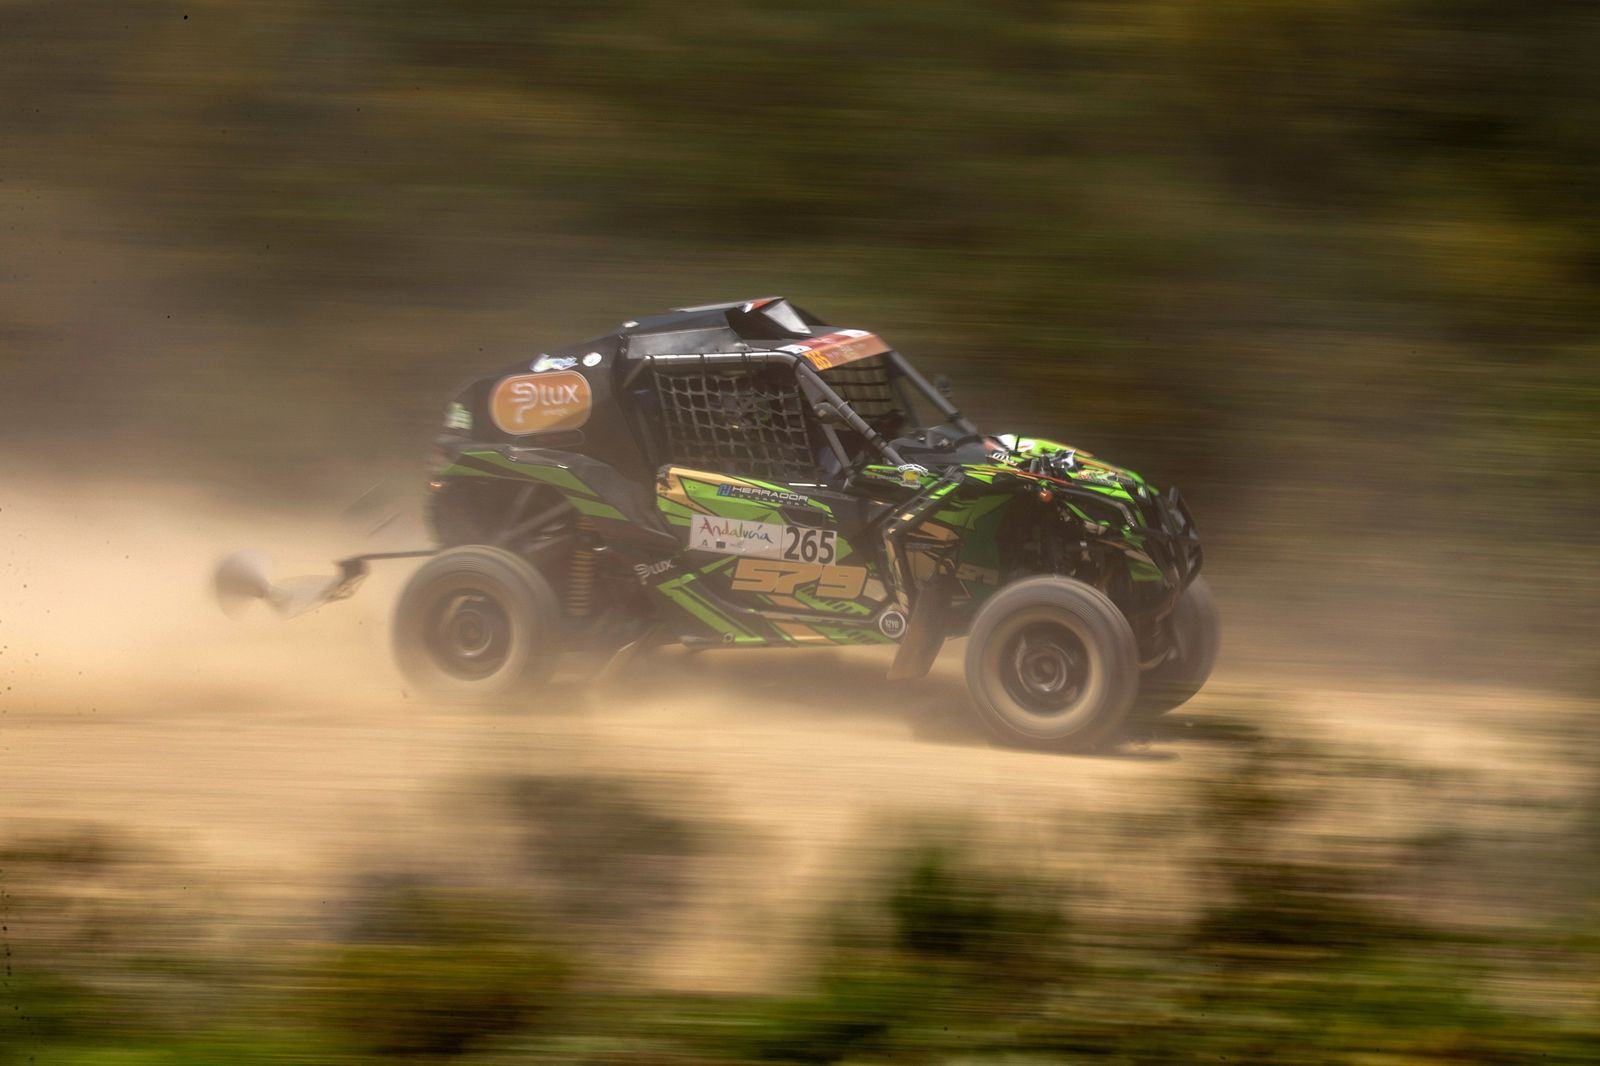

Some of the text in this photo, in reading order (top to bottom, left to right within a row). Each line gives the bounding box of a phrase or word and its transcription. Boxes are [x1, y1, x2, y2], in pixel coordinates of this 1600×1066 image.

[732, 486, 809, 501] HERRADOR
[699, 516, 774, 544] Andalucía
[784, 526, 834, 564] 265
[731, 558, 867, 599] 579
